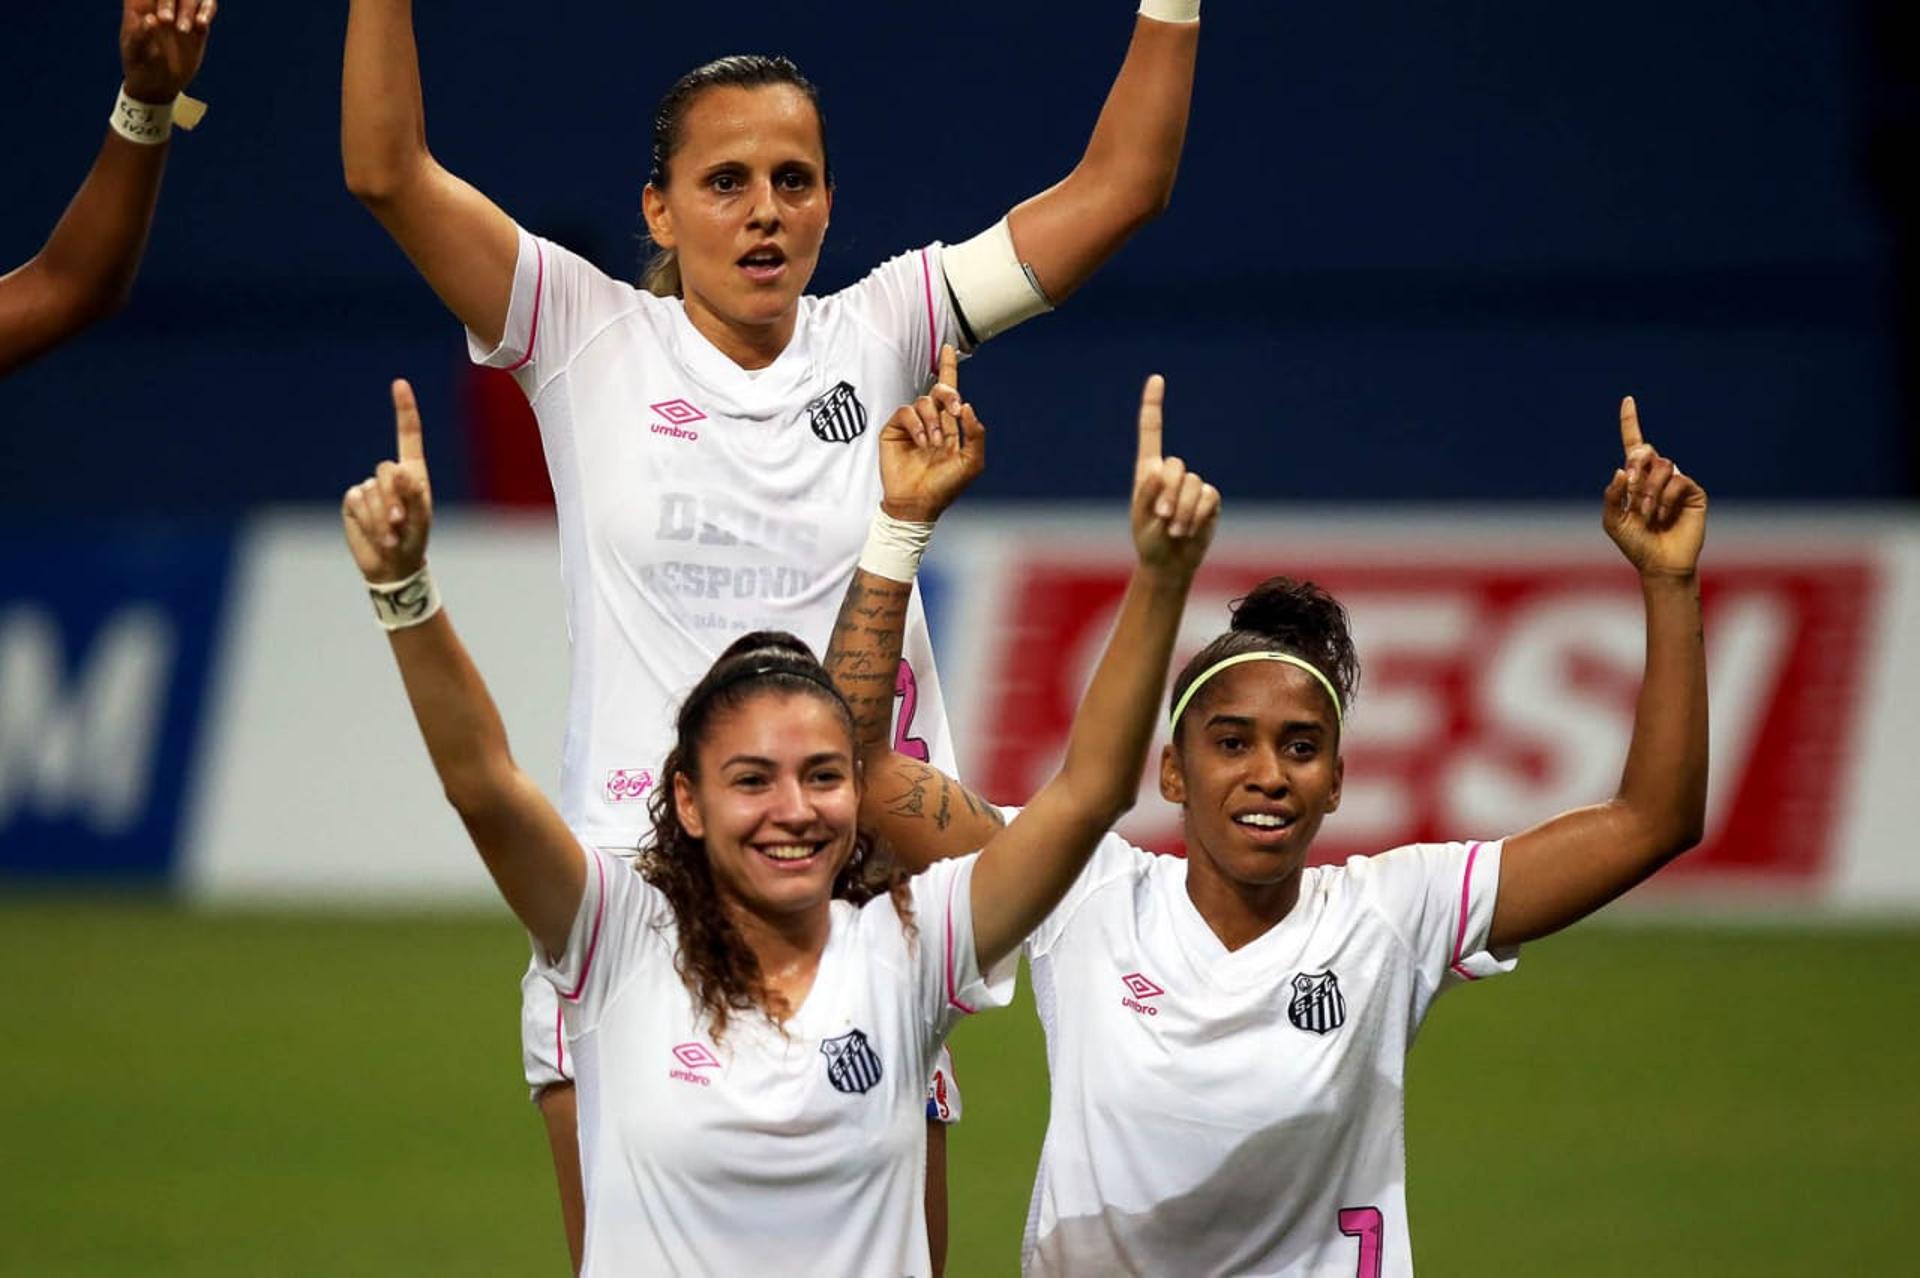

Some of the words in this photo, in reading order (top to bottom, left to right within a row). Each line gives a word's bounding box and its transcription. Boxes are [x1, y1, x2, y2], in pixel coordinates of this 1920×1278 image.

[650, 423, 699, 441] umbro
[1121, 996, 1158, 1016] umbro
[669, 1069, 711, 1087] umbro
